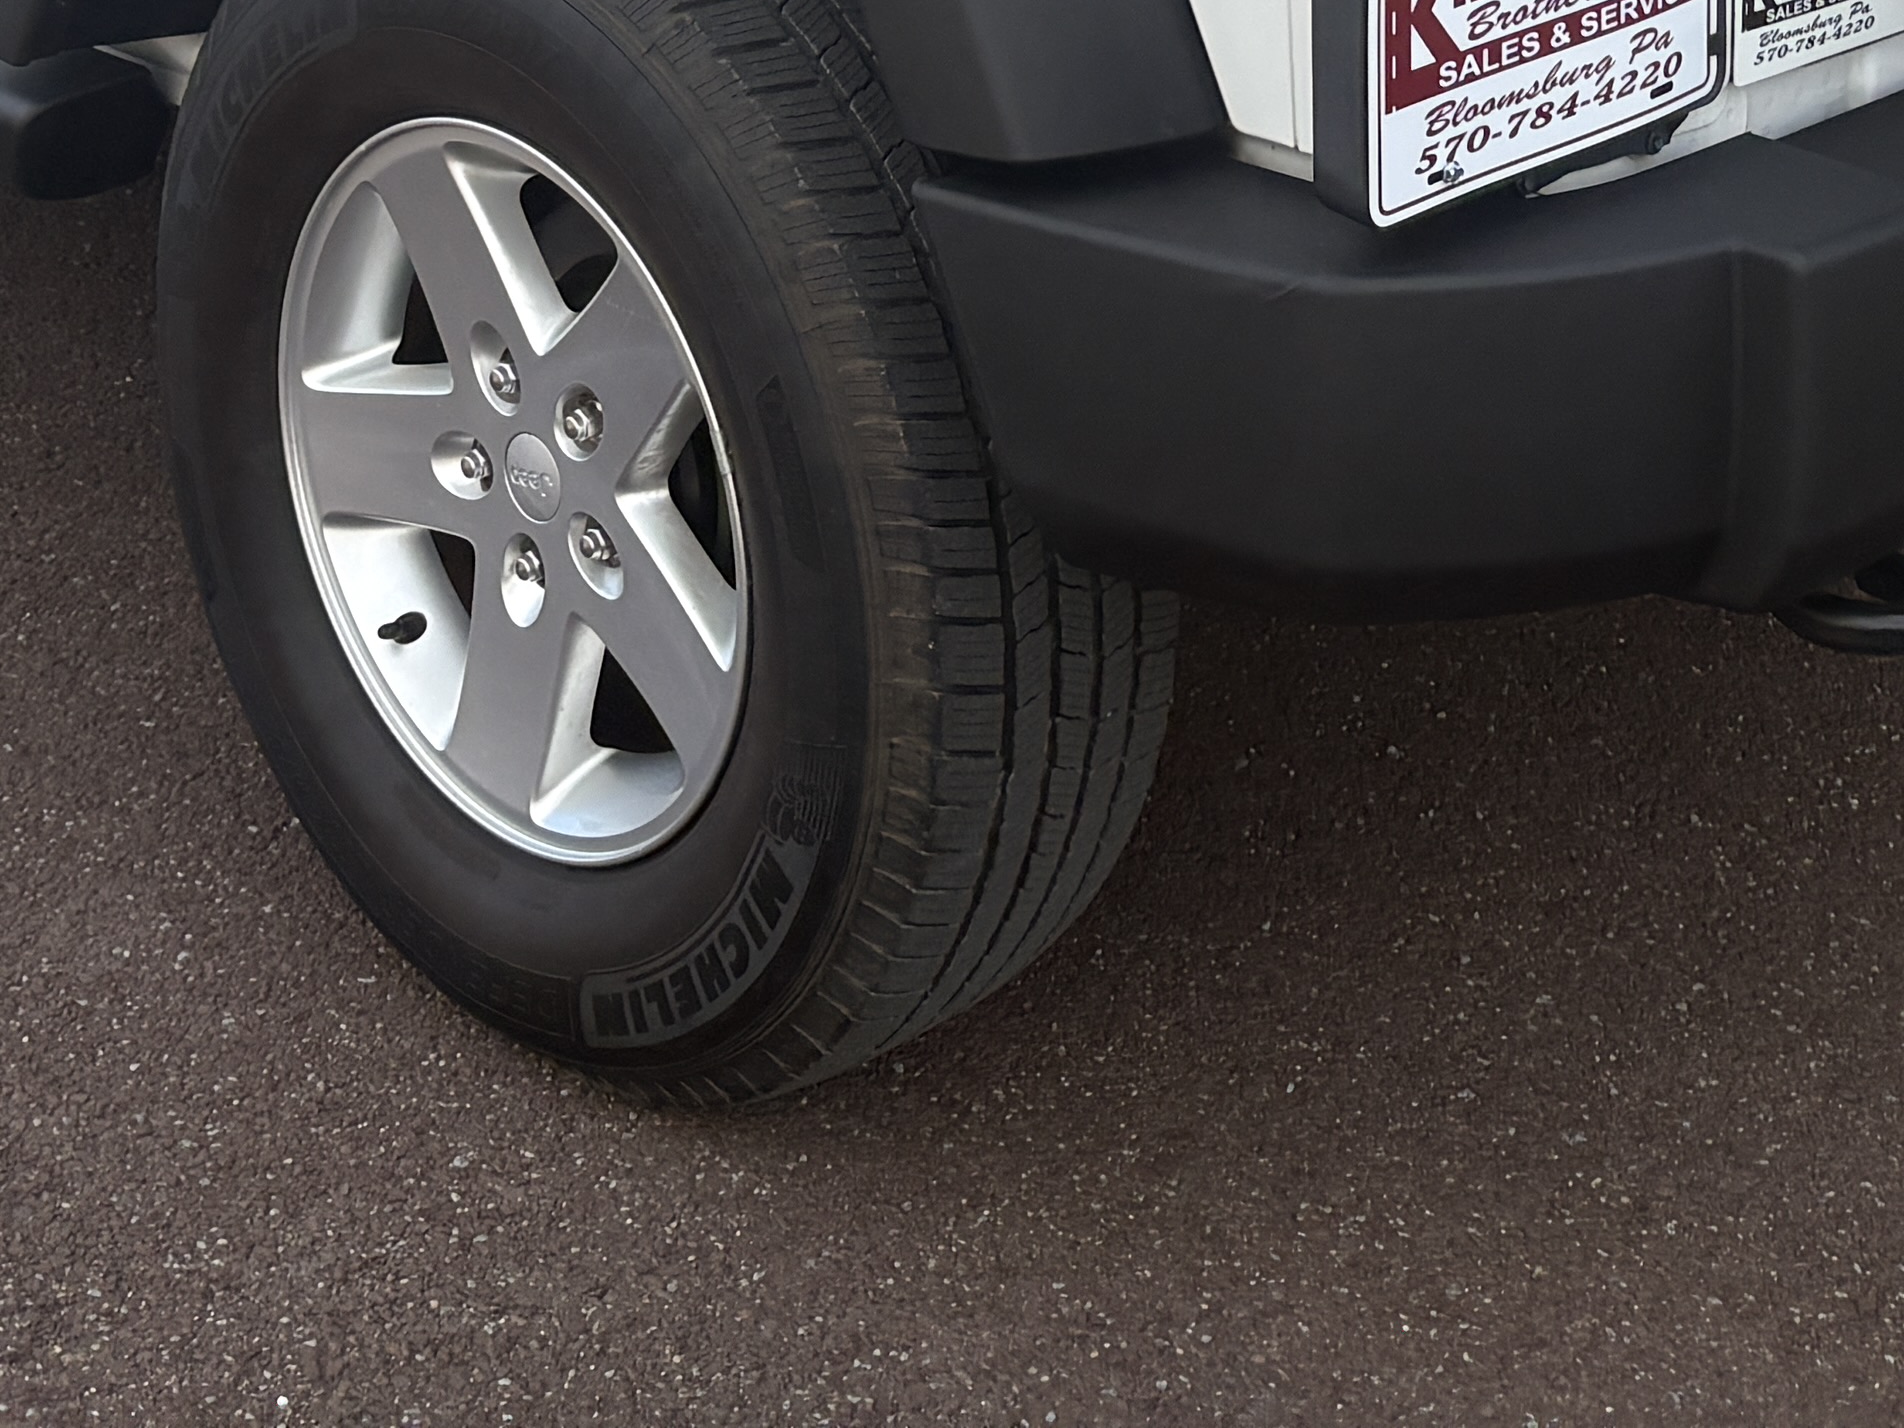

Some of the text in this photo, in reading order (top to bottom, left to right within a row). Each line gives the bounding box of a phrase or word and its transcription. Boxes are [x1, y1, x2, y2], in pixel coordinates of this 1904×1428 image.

[1438, 30, 1540, 88] SALES
[1550, 21, 1571, 48] &
[1753, 15, 1876, 66] 570-784-4220
[1759, 1, 1873, 48] Bloomsburg Pa
[1414, 51, 1683, 176] 570-784-4220
[1424, 26, 1674, 138] Bloomsburg Pa
[590, 847, 795, 1037] MICHELIN
